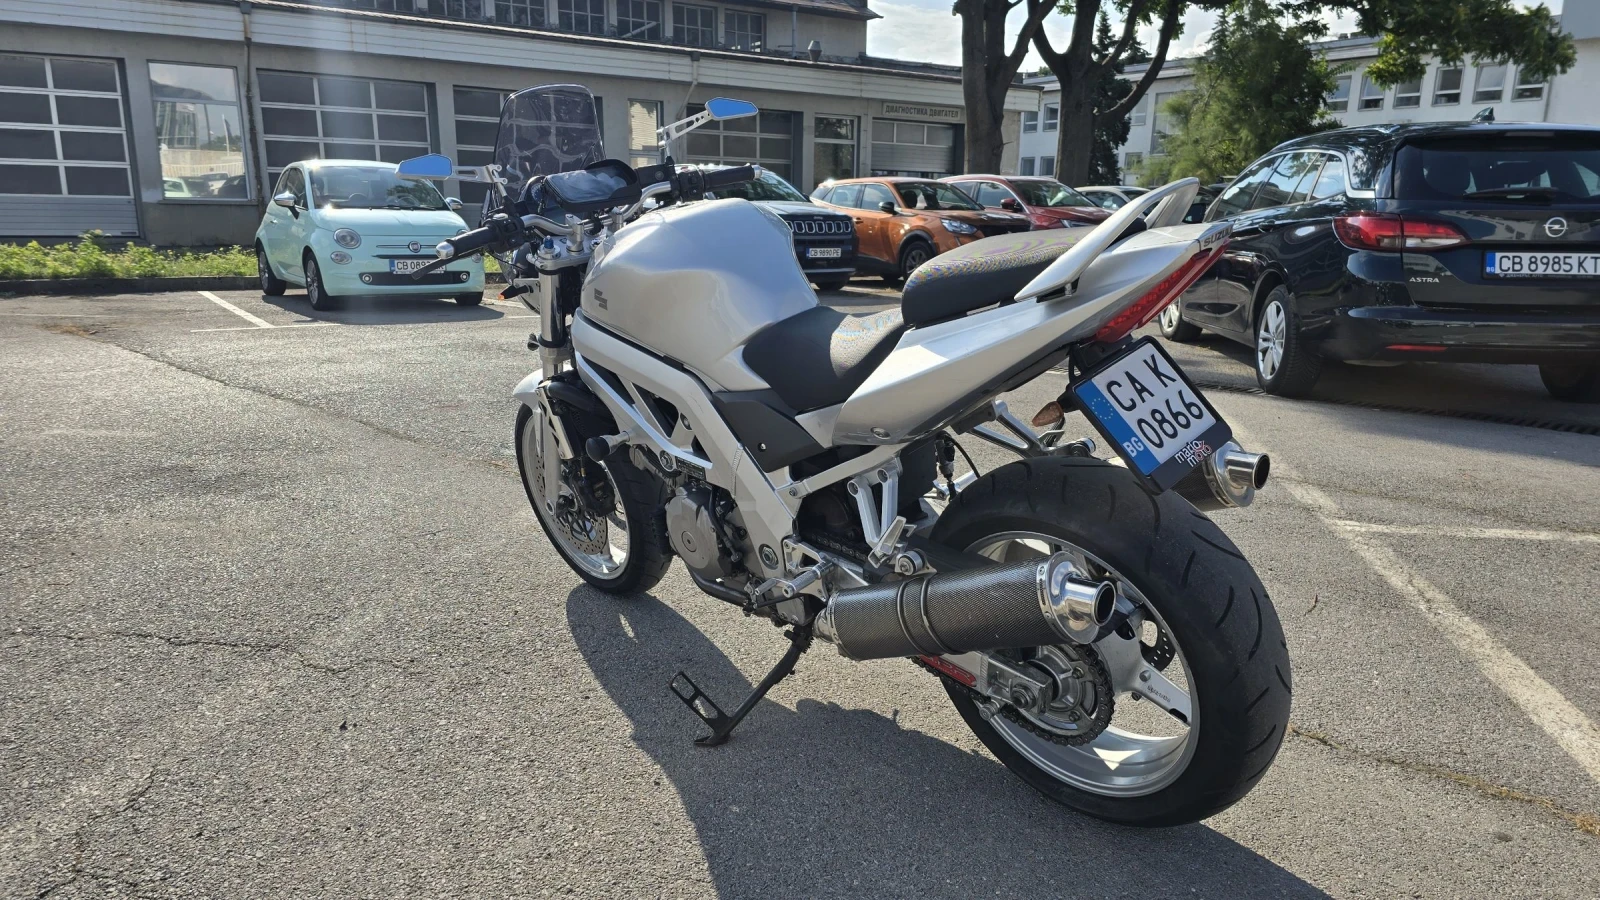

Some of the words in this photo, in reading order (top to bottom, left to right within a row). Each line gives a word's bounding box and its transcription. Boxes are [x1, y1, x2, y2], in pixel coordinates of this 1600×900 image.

[885, 105, 928, 116] ДИАГНОСТИКА
[929, 108, 959, 118] ДВИГАТЕЛ
[396, 261, 408, 270] CB
[410, 261, 430, 270] 089
[1499, 255, 1523, 272] CB
[1528, 256, 1573, 273] 8985
[1578, 256, 1600, 273] KT
[1106, 370, 1155, 412] CA
[1143, 353, 1177, 388] K
[1136, 389, 1204, 449] 0866
[1122, 436, 1145, 458] BG
[1174, 440, 1201, 464] mario
[1187, 445, 1212, 468] moto
